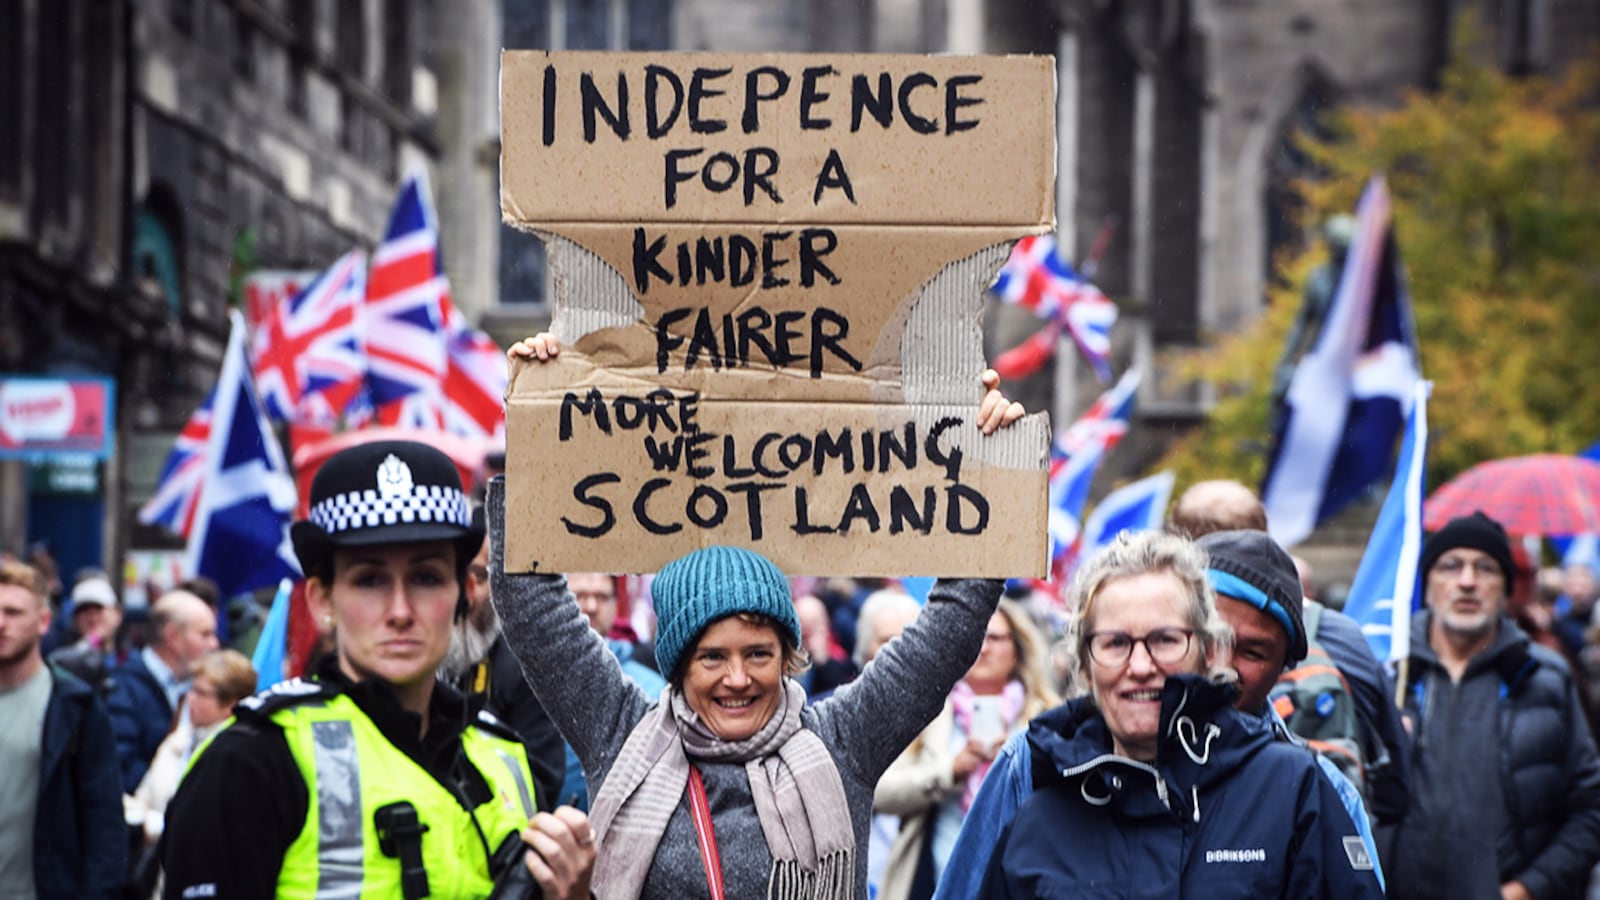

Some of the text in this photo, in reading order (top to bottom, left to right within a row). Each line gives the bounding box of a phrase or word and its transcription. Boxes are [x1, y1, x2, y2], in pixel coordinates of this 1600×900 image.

[543, 65, 985, 146] INDEPENCE
[665, 147, 856, 208] FOR A
[633, 227, 842, 294] KINDER
[654, 306, 863, 379] FAIRER
[559, 389, 700, 441] MORE
[645, 418, 963, 480] WELCOMING
[560, 473, 990, 541] SCOTLAND
